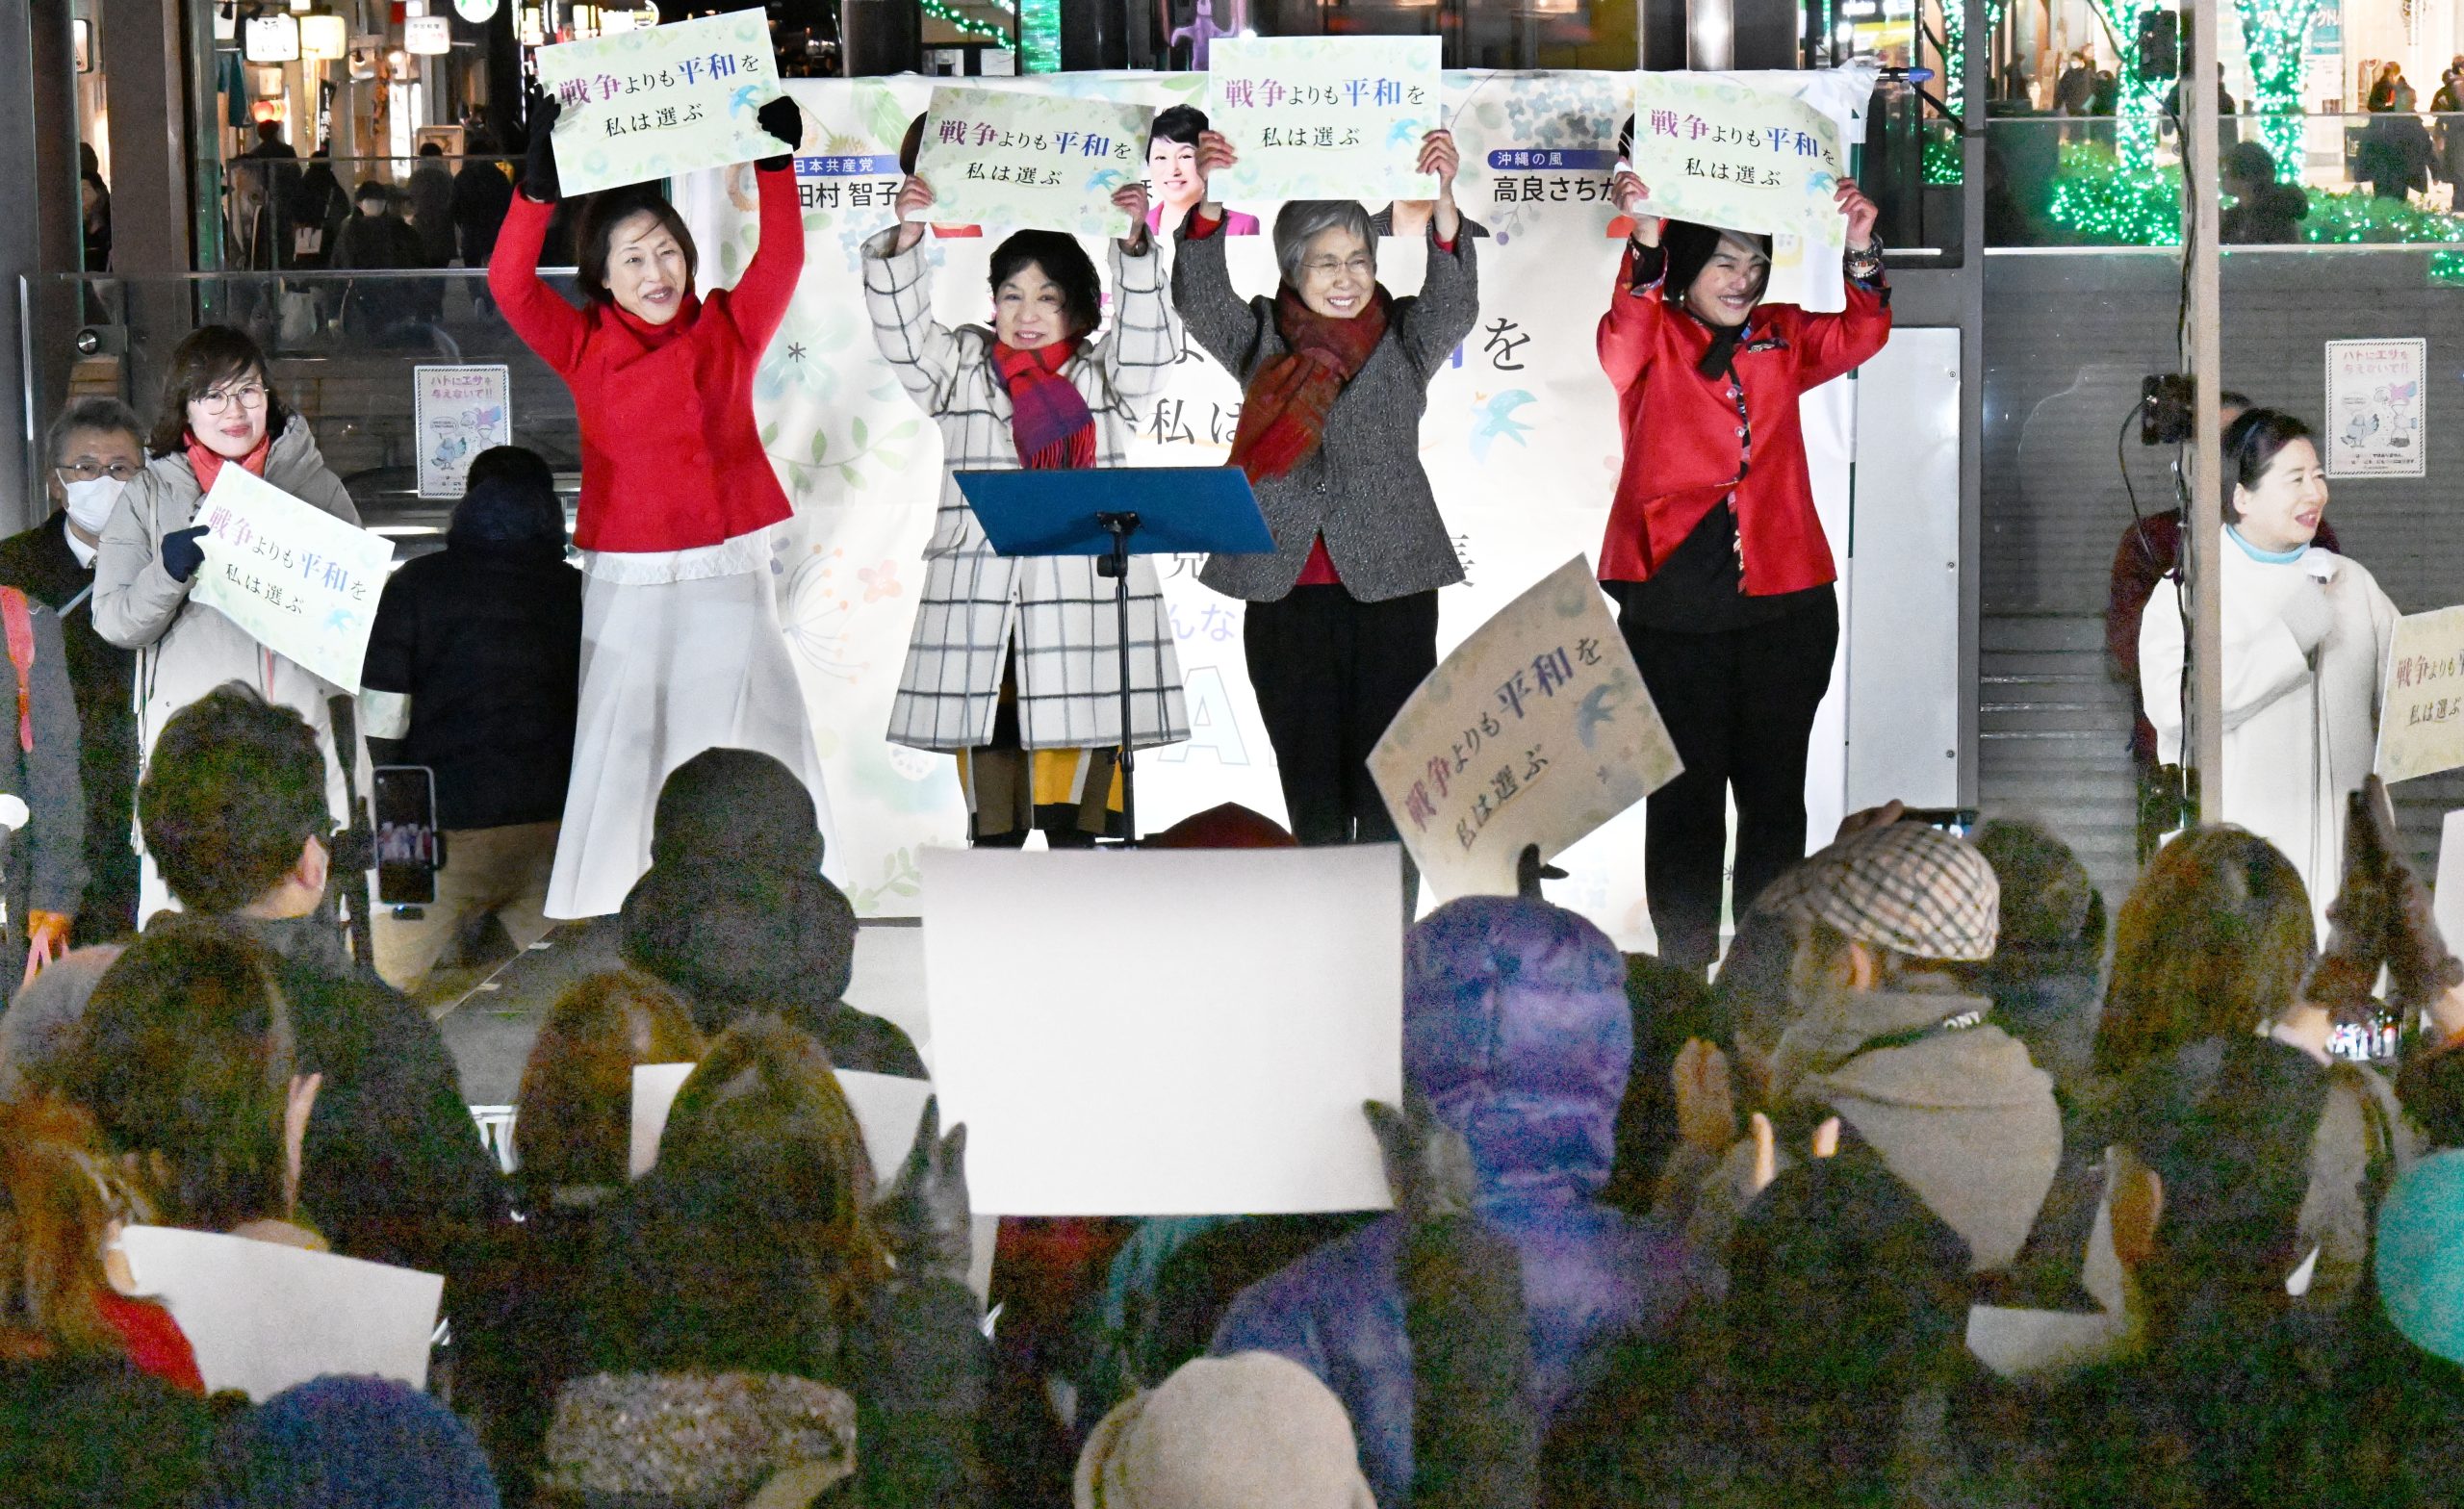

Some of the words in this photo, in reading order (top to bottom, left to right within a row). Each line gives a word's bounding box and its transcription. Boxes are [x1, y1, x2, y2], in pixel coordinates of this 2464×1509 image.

[558, 53, 759, 107] 戦争よりも平和を
[1225, 78, 1425, 109] 戦争よりも平和を
[604, 103, 704, 137] 私は選ぶ
[1262, 127, 1361, 147] 私は選ぶ
[938, 119, 1131, 160] 戦争よりも平和を
[1651, 109, 1835, 166] 戦争よりも平和を
[795, 158, 874, 172] 日本共産党
[966, 162, 1063, 185] 私は選ぶ
[1498, 151, 1563, 166] 沖縄の風
[1684, 158, 1781, 186] 私は選ぶ
[209, 505, 367, 601] 戦争よりも平和を
[226, 563, 304, 614] 私は選ぶ
[2409, 696, 2462, 726] 私は選ぶ
[1404, 637, 1603, 832] 戦争よりも平和を
[1454, 744, 1549, 852] 私は選ぶ
